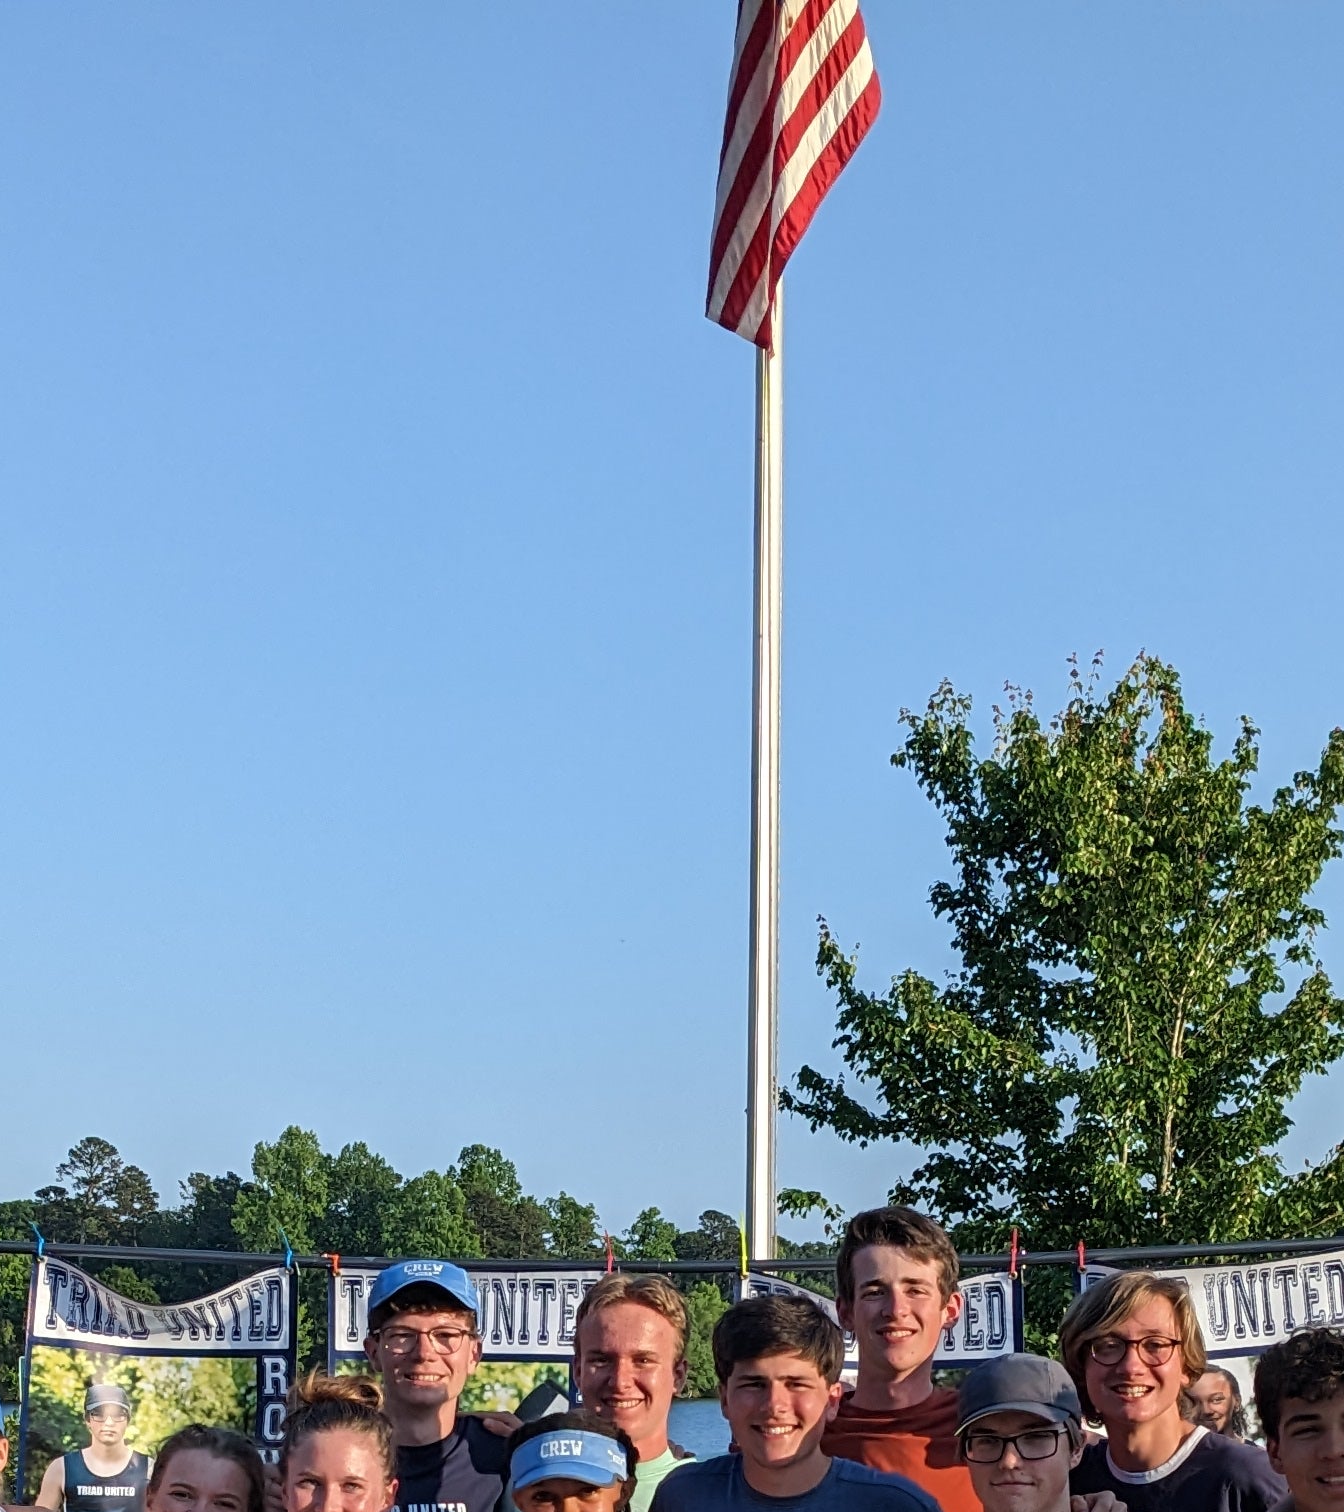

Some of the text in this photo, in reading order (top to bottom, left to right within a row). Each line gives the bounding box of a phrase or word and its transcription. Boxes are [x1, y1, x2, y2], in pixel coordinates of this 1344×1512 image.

[403, 1263, 444, 1273] CREW
[44, 1263, 150, 1340] TRIAD
[154, 1275, 283, 1342] UNITED
[540, 1440, 583, 1459] CREW
[77, 1485, 136, 1497] TRIAD UNITED
